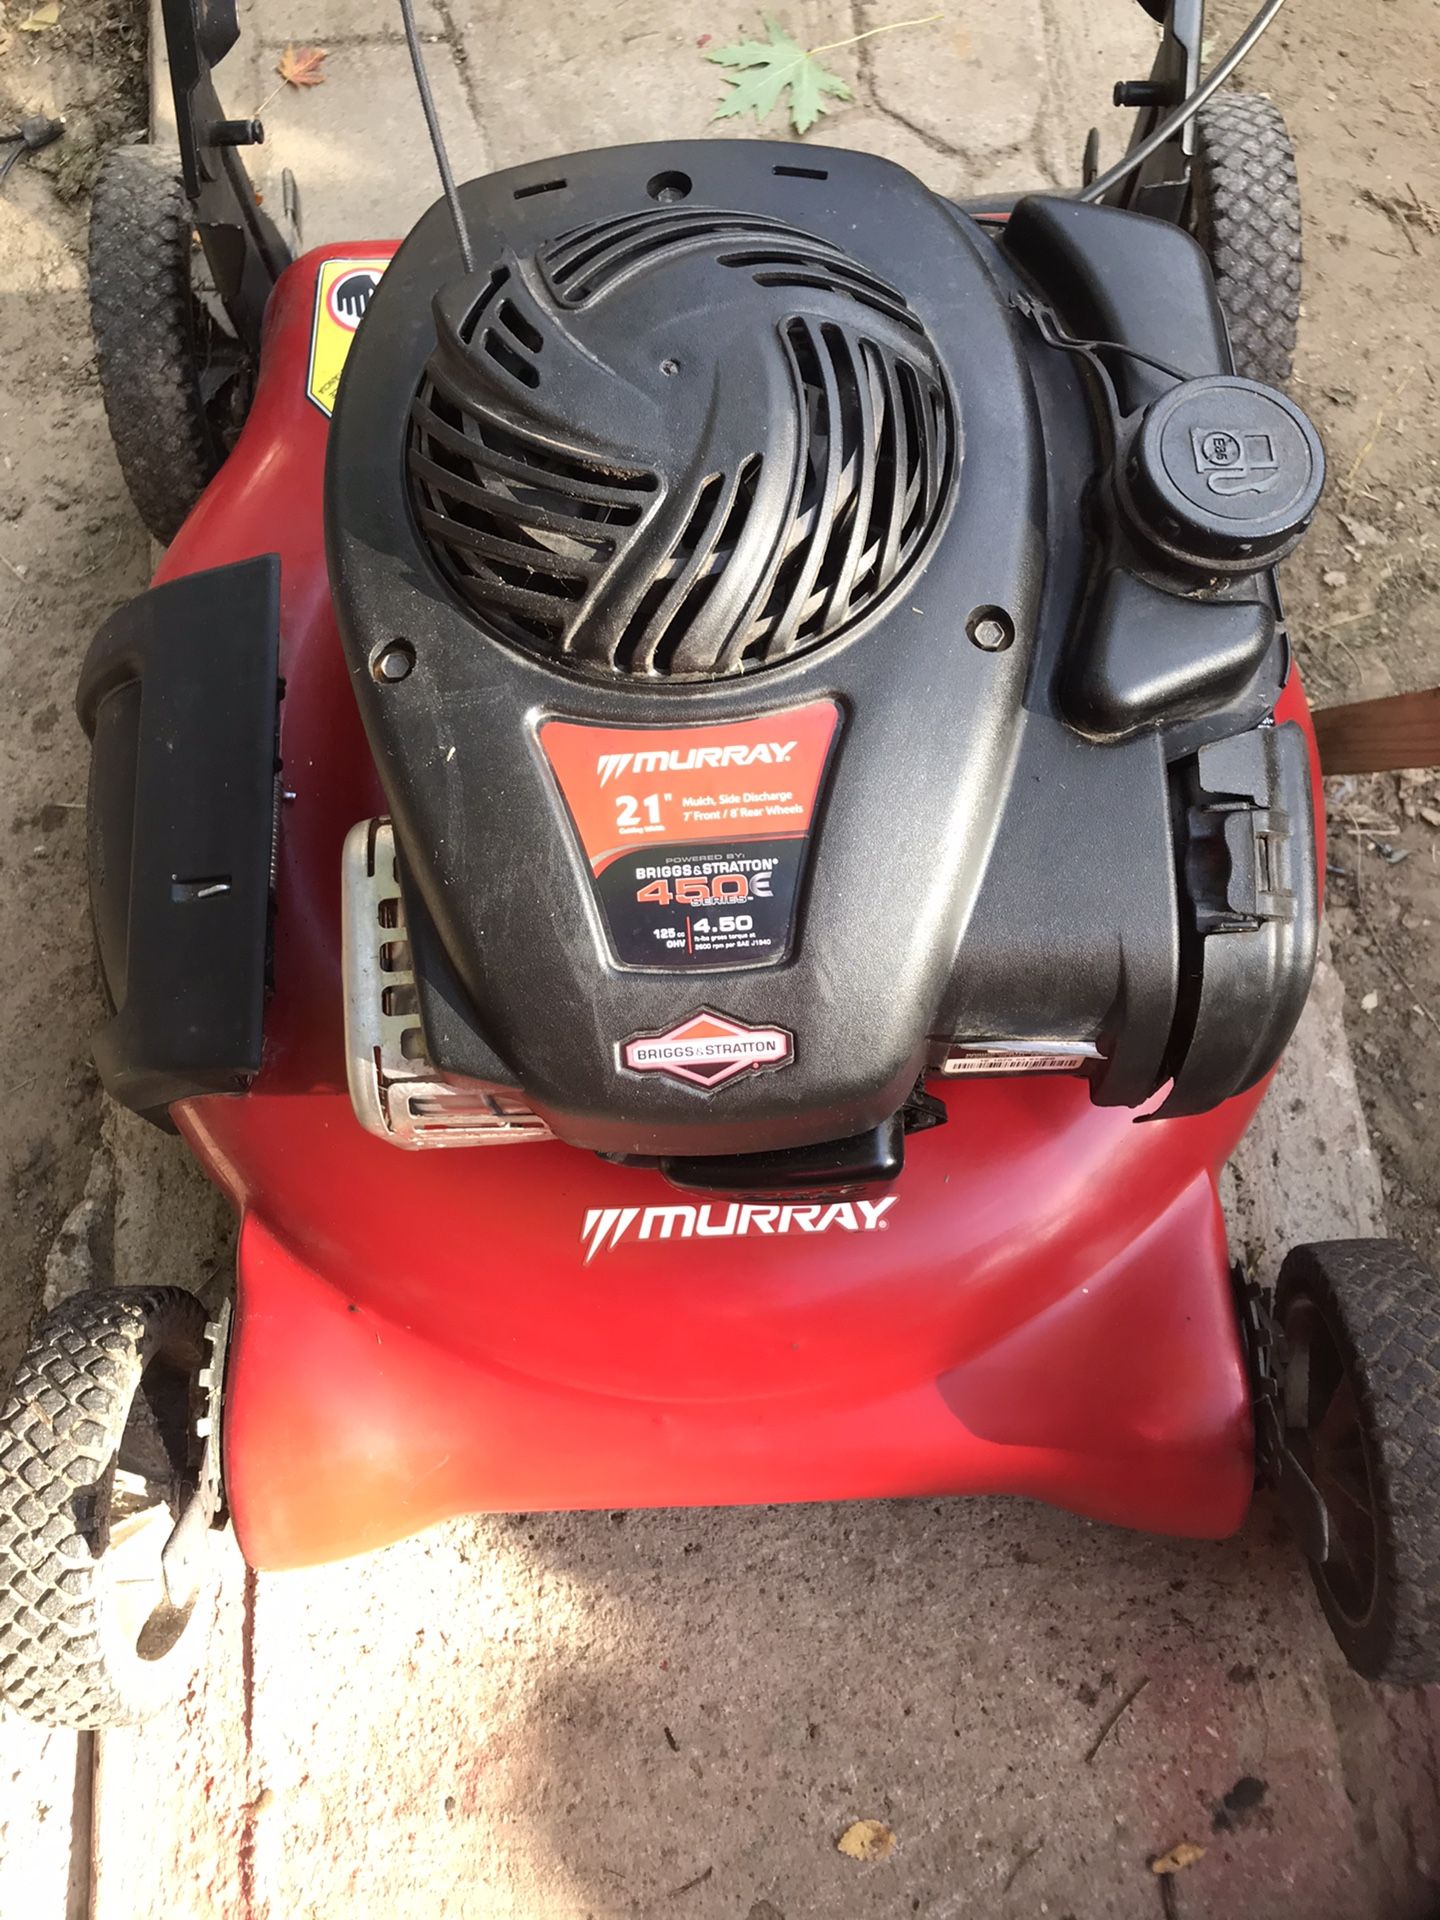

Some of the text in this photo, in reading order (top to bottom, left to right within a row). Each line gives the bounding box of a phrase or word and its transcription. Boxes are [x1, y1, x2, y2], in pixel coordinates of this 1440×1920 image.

[633, 741, 797, 773] MURRAY
[682, 790, 793, 807] Mulch, Side Discharge
[615, 793, 672, 826] 21"
[694, 810, 721, 821] Front
[741, 806, 764, 818] Rear
[765, 804, 804, 816] Wheels
[665, 854, 723, 864] POWERED
[690, 895, 748, 907] SERIES
[693, 914, 753, 933] 4.50
[653, 928, 676, 940] 125
[711, 934, 728, 942] gross
[729, 933, 749, 941] torque
[666, 940, 686, 949] OHV
[713, 942, 725, 950] rpm
[726, 941, 736, 949] per
[638, 1196, 899, 1240] MURRAY
